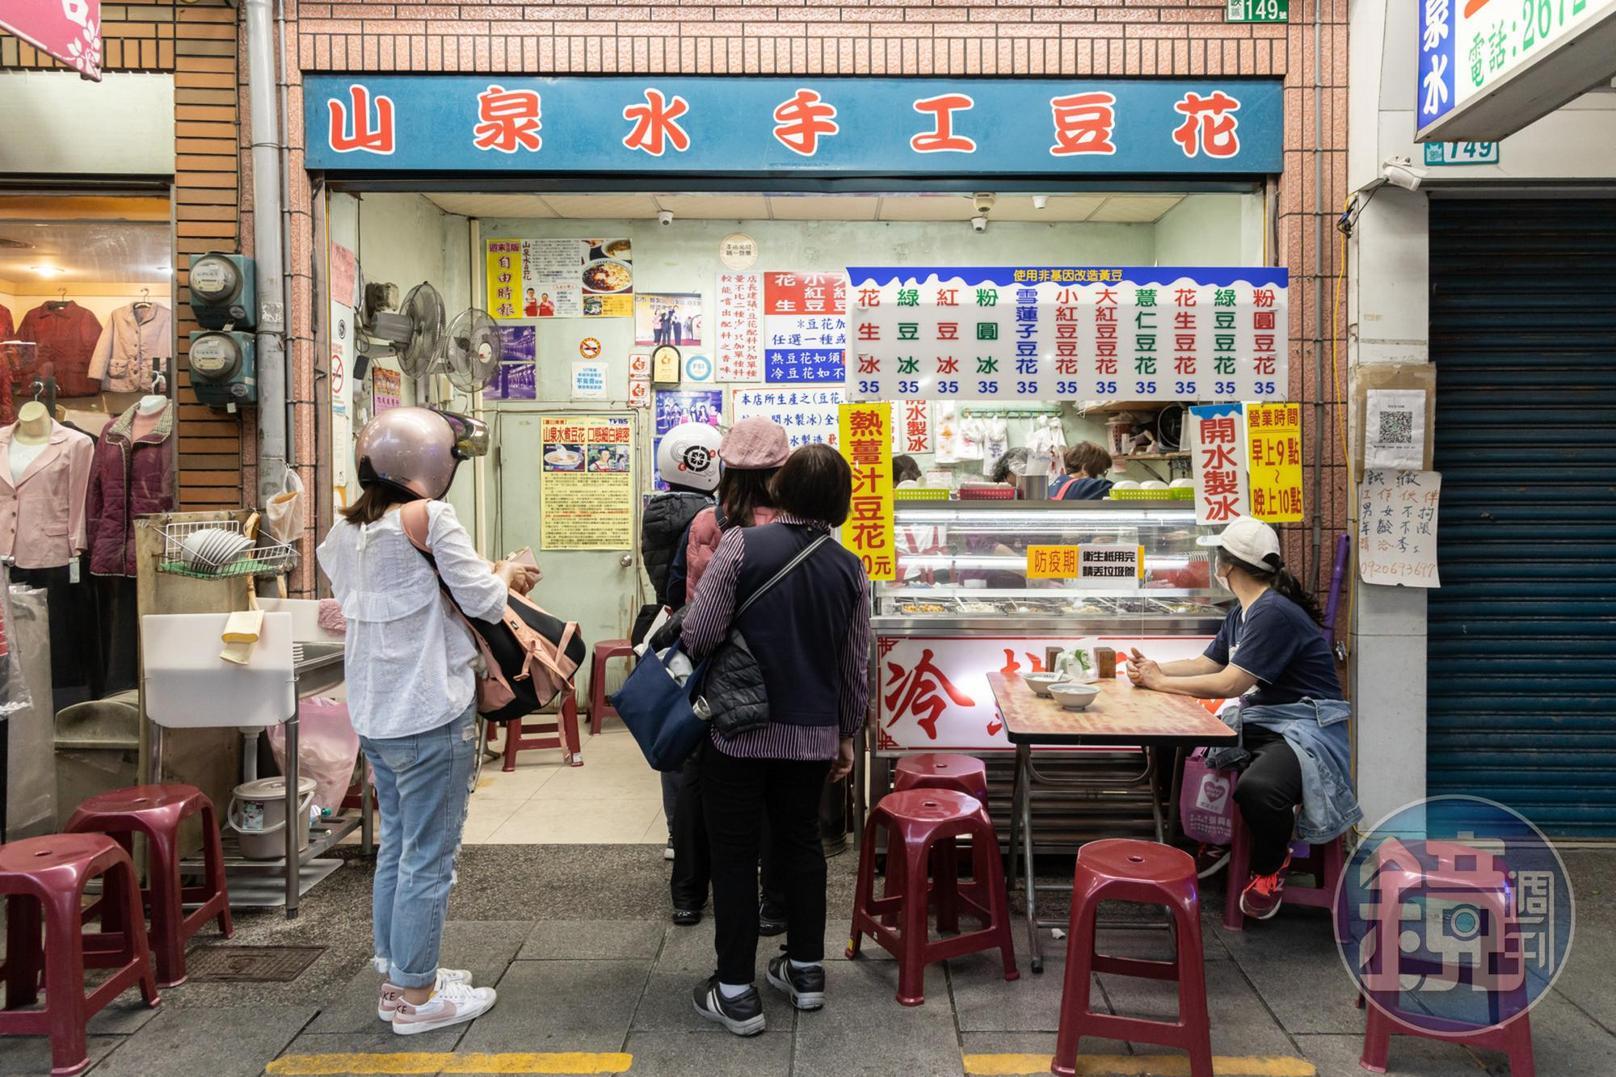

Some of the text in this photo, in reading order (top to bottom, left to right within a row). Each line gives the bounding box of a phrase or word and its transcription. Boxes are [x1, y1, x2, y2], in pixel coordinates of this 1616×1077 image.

[327, 84, 1241, 158] 山泉水手工豆花
[1013, 269, 1123, 282] 使用非基因改造黃豆
[858, 288, 880, 394] 花生冰 35
[897, 288, 920, 394] 綠豆冰 35
[936, 288, 960, 394] 紅豆冰 35
[976, 288, 998, 394] 粉圓冰 35
[1016, 288, 1038, 394] 雪蓮子豆花 35
[1056, 288, 1078, 394] 小紅豆豆花 35
[1095, 288, 1118, 394] 大紅豆豆花 35
[1135, 381, 1157, 394] 35
[1174, 288, 1196, 394] 花生豆花 35
[1214, 288, 1236, 394] 綠豆豆花 35
[1253, 288, 1276, 394] 粉圓豆花 35
[1200, 418, 1240, 520] 開水製冰
[1248, 408, 1298, 427] 營業時間
[1252, 437, 1299, 466] 早上9點
[850, 411, 885, 550] 熱薑汁豆花
[1253, 487, 1302, 515] 晚上10點
[1034, 550, 1075, 573] 防疫期
[885, 648, 976, 740] 冷
